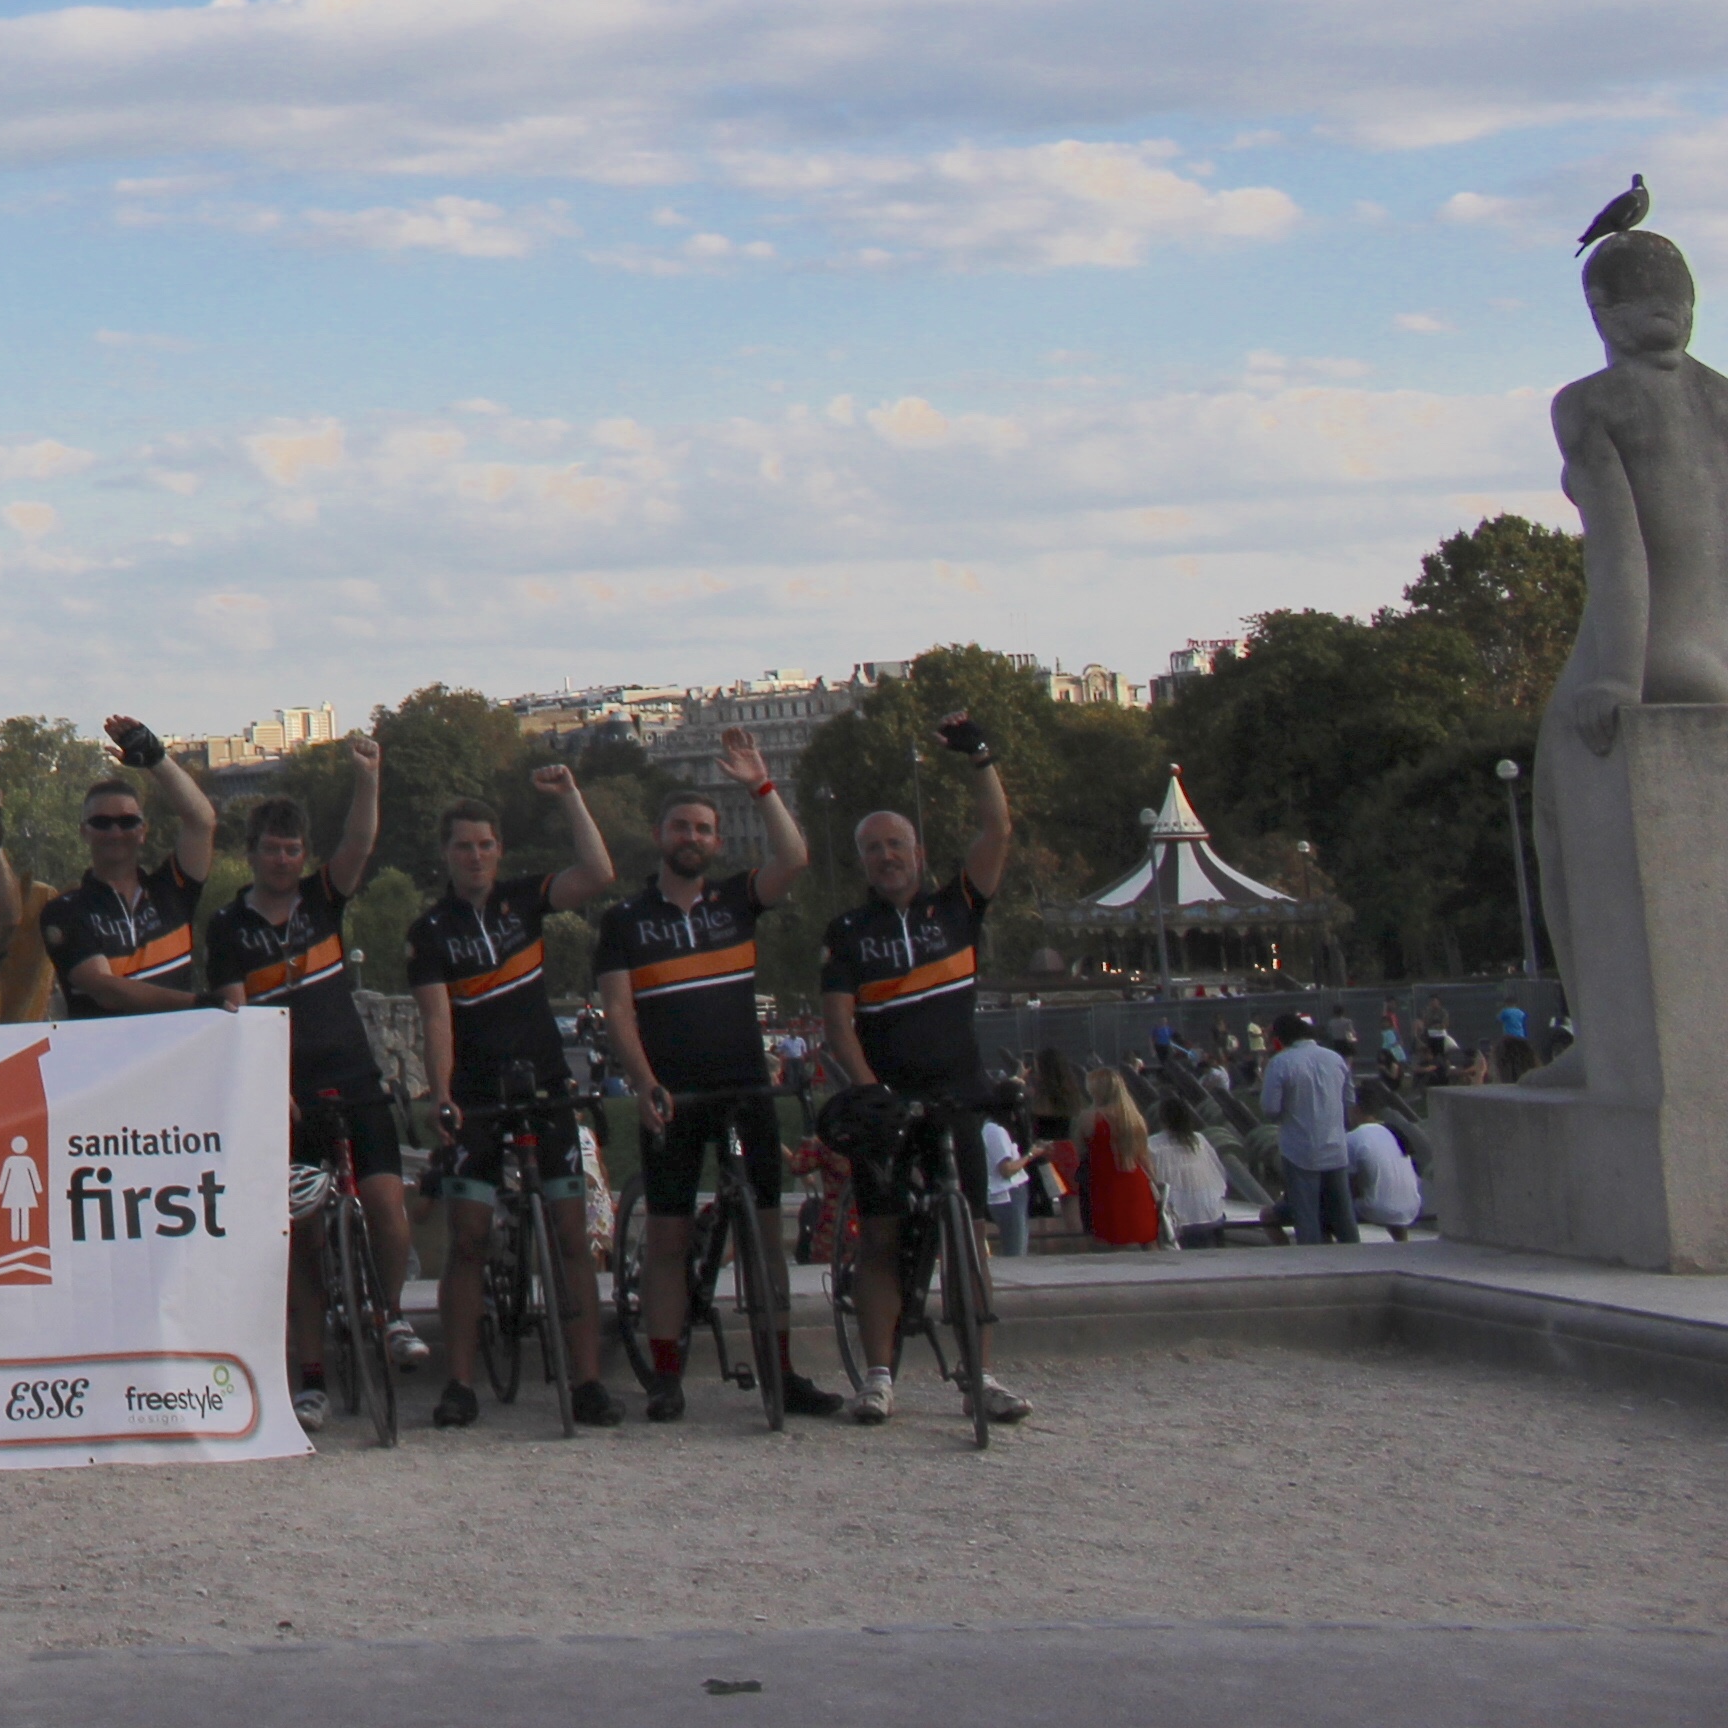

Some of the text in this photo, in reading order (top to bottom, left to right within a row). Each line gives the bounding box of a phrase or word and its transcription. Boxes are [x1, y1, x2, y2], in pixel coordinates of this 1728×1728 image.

[859, 924, 942, 968] Ripes
[67, 1125, 221, 1157] sanitation
[66, 1167, 226, 1241] first
[6, 1378, 90, 1422] ESSE
[124, 1385, 223, 1419] freestyle
